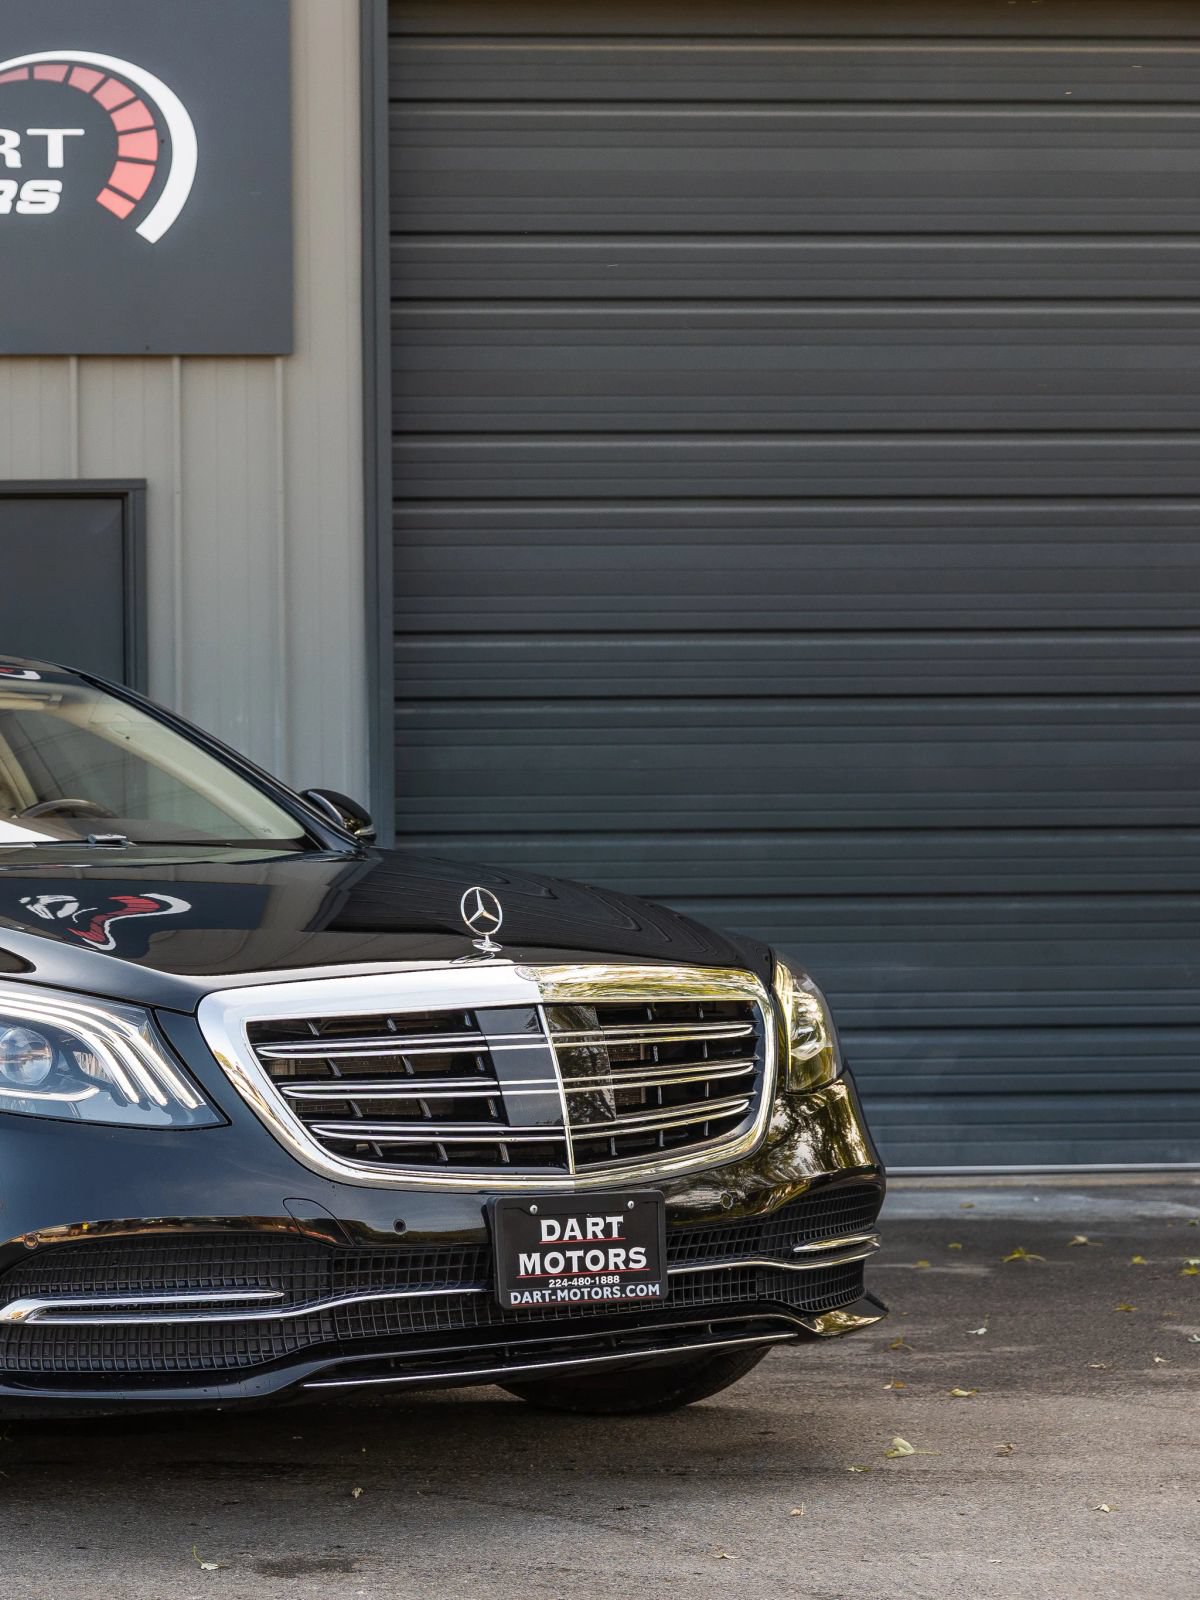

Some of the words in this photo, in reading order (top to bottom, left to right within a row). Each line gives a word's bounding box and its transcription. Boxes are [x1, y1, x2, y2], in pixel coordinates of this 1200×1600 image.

[540, 1215, 624, 1242] DART
[518, 1247, 647, 1276] MOTORS
[548, 1275, 620, 1288] 224-480-1888
[510, 1283, 660, 1305] DART-MOTORS.COM
